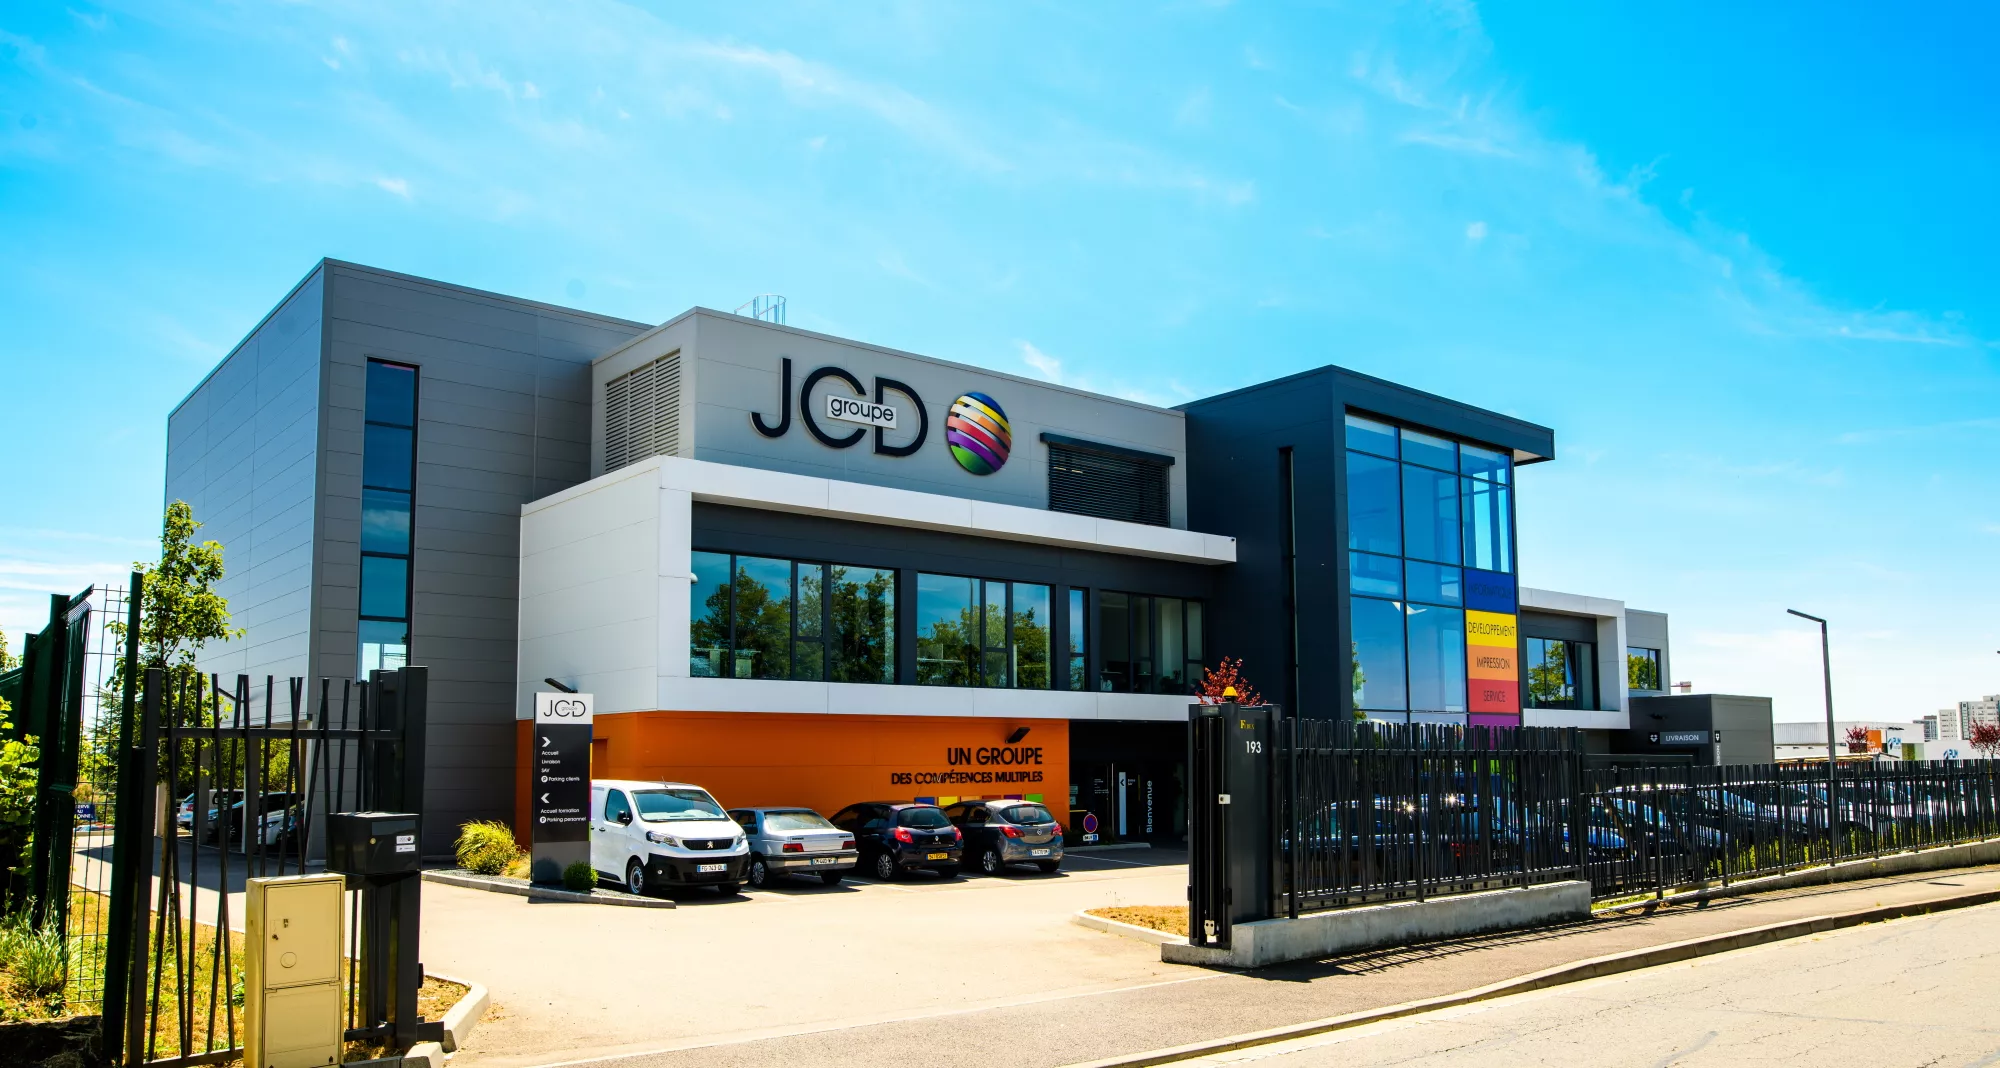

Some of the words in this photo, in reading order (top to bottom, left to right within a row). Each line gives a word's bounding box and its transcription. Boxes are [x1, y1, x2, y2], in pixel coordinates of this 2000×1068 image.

[749, 357, 929, 457] JCD
[830, 397, 894, 422] groupe
[1468, 621, 1515, 638] DEVELOPPEMENT
[1476, 656, 1510, 670] IMPRESSION
[1483, 690, 1506, 703] SERVICE
[543, 700, 586, 717] JCD
[1665, 734, 1699, 742] LIVRAISON
[1245, 740, 1262, 754] 193
[947, 747, 971, 765] UN
[976, 747, 1043, 765] GROUPE
[891, 772, 912, 785] DES
[914, 769, 992, 784] COMPÉTENCES
[995, 771, 1043, 783] MULTIPLES
